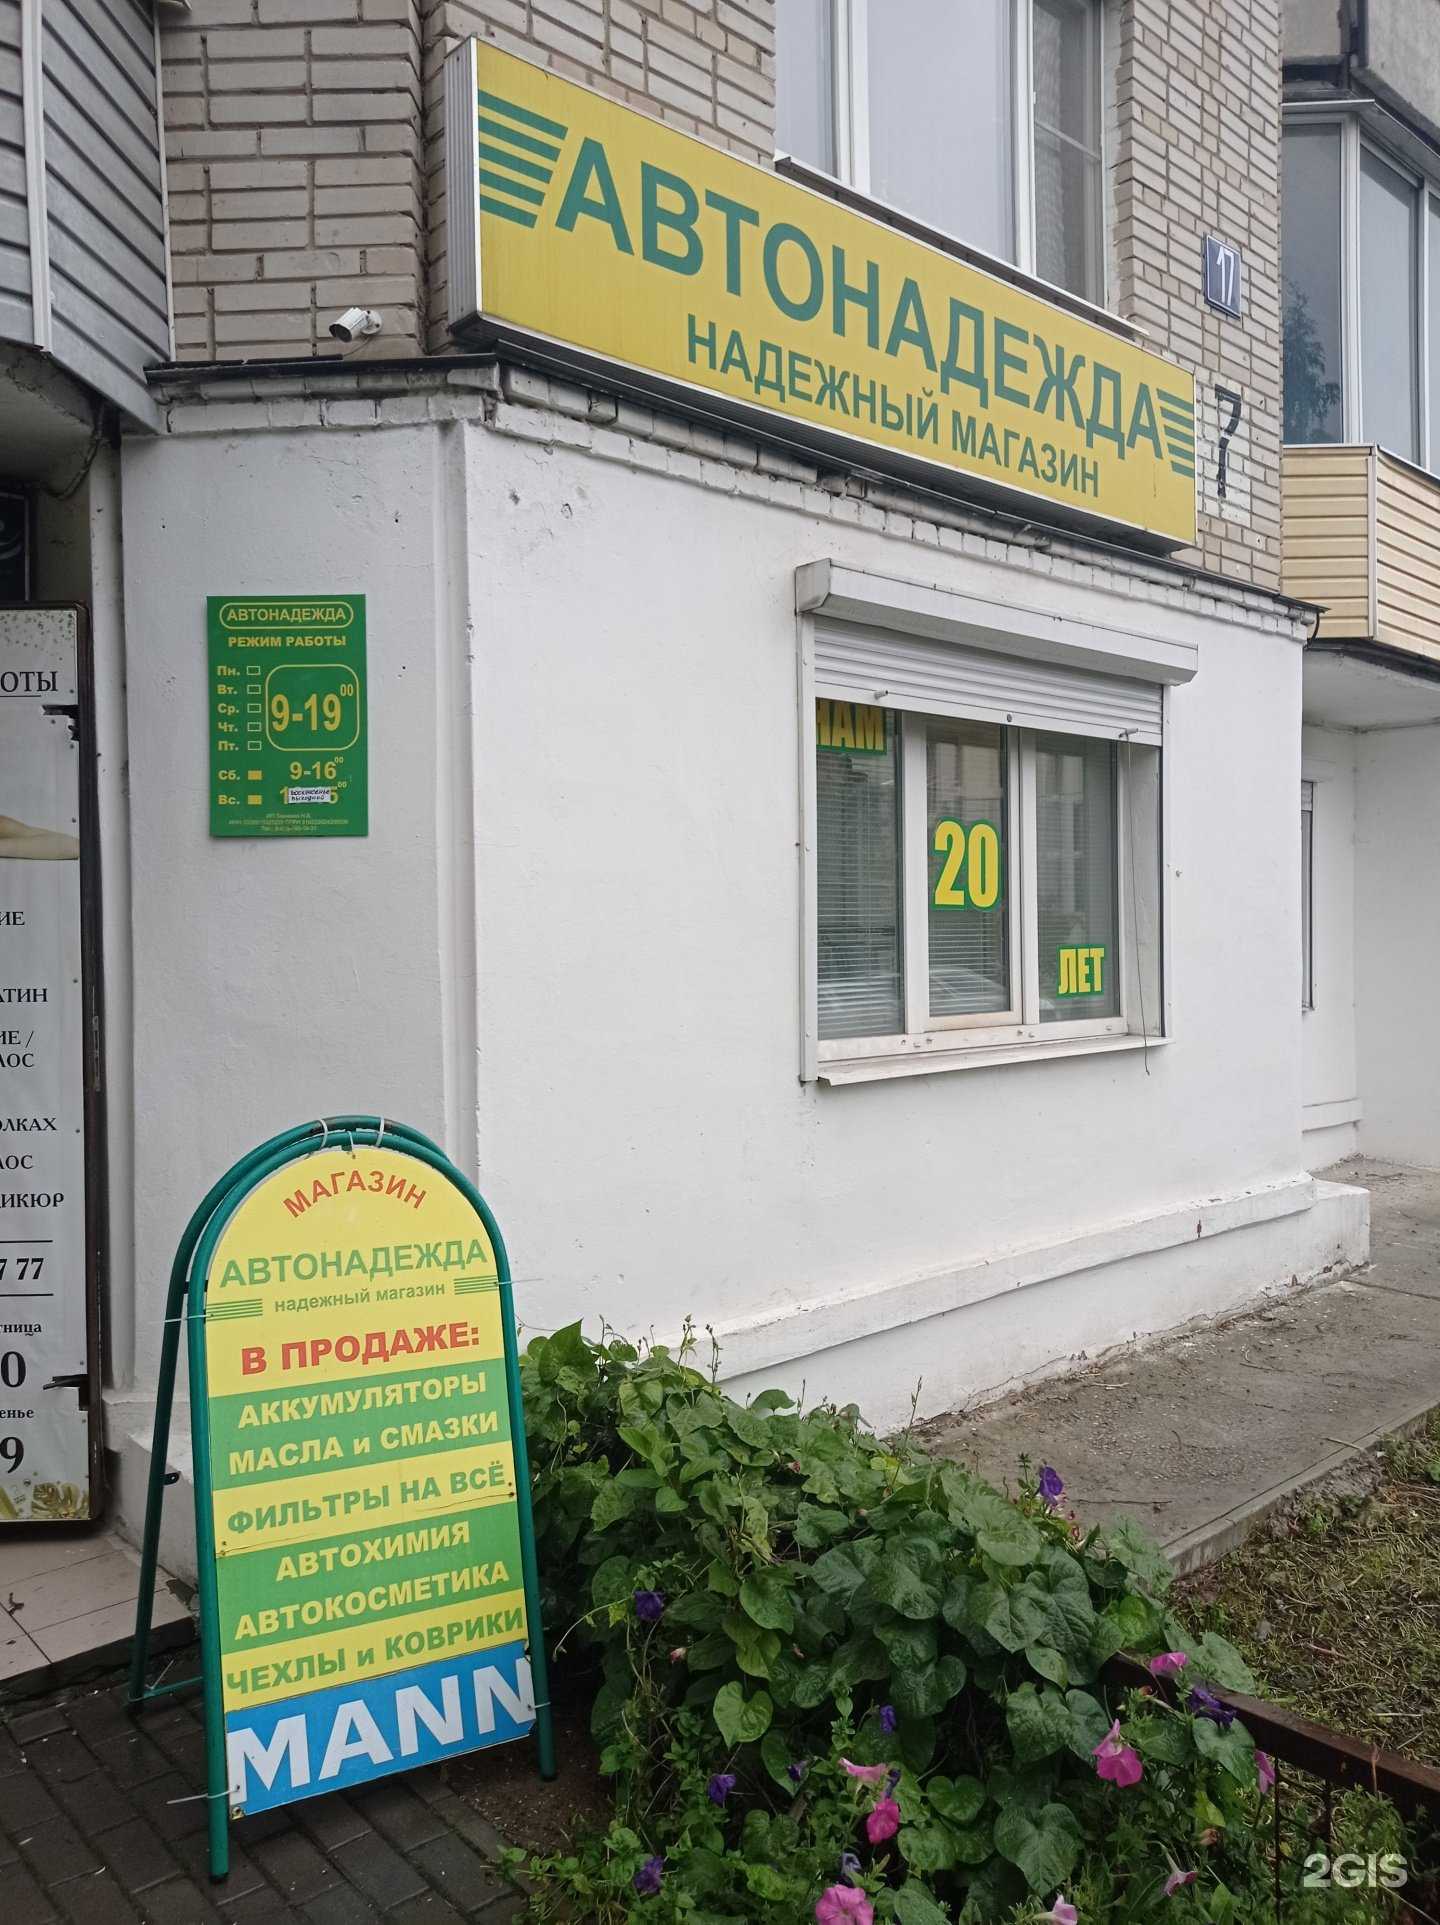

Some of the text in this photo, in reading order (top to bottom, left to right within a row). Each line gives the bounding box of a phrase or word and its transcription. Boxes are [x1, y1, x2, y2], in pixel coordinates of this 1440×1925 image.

[554, 136, 1166, 461] АВТОНАДЕЖДА
[1216, 246, 1235, 306] 17
[687, 313, 1101, 498] НАДЕЖНЫЙ МАГАЗИН
[226, 607, 347, 623] АВТОНАДЕЖДА
[228, 635, 347, 648] РЕЖИМ РАБОТЫ
[217, 665, 240, 676] Пн.
[217, 684, 238, 694] Вт.
[217, 703, 239, 715] Ср.
[218, 722, 238, 732] Чт.
[218, 741, 239, 751] Пт.
[218, 769, 240, 780] Сб.
[934, 820, 999, 908] 20
[1058, 947, 1105, 994] ЛЕТ
[0, 1117, 57, 1132] ЛКАХ
[0, 1192, 65, 1208] ИКЮР
[283, 1169, 428, 1218] МАГАЗИН
[16, 1257, 44, 1280] 77
[219, 1239, 488, 1288] АВТОНАДЕЖДА
[274, 1282, 446, 1314] надежный магазин
[0, 1323, 42, 1337] ница
[241, 1321, 481, 1375] В ПРОДАЖЕ:
[238, 1371, 487, 1429] АККУМУЛЯТОРЫ
[228, 1411, 498, 1475] МАСЛА и СМАЗКИ
[227, 1461, 506, 1534] ФИЛЬТРЫ НА ВСЁ
[275, 1521, 470, 1582] АВТОХИМИЯ
[234, 1560, 510, 1640] АВТОКОСМЕТИКА
[226, 1607, 524, 1695] ЧЕХЛЫ и КОВРИКИ
[225, 1654, 537, 1805] MANN
